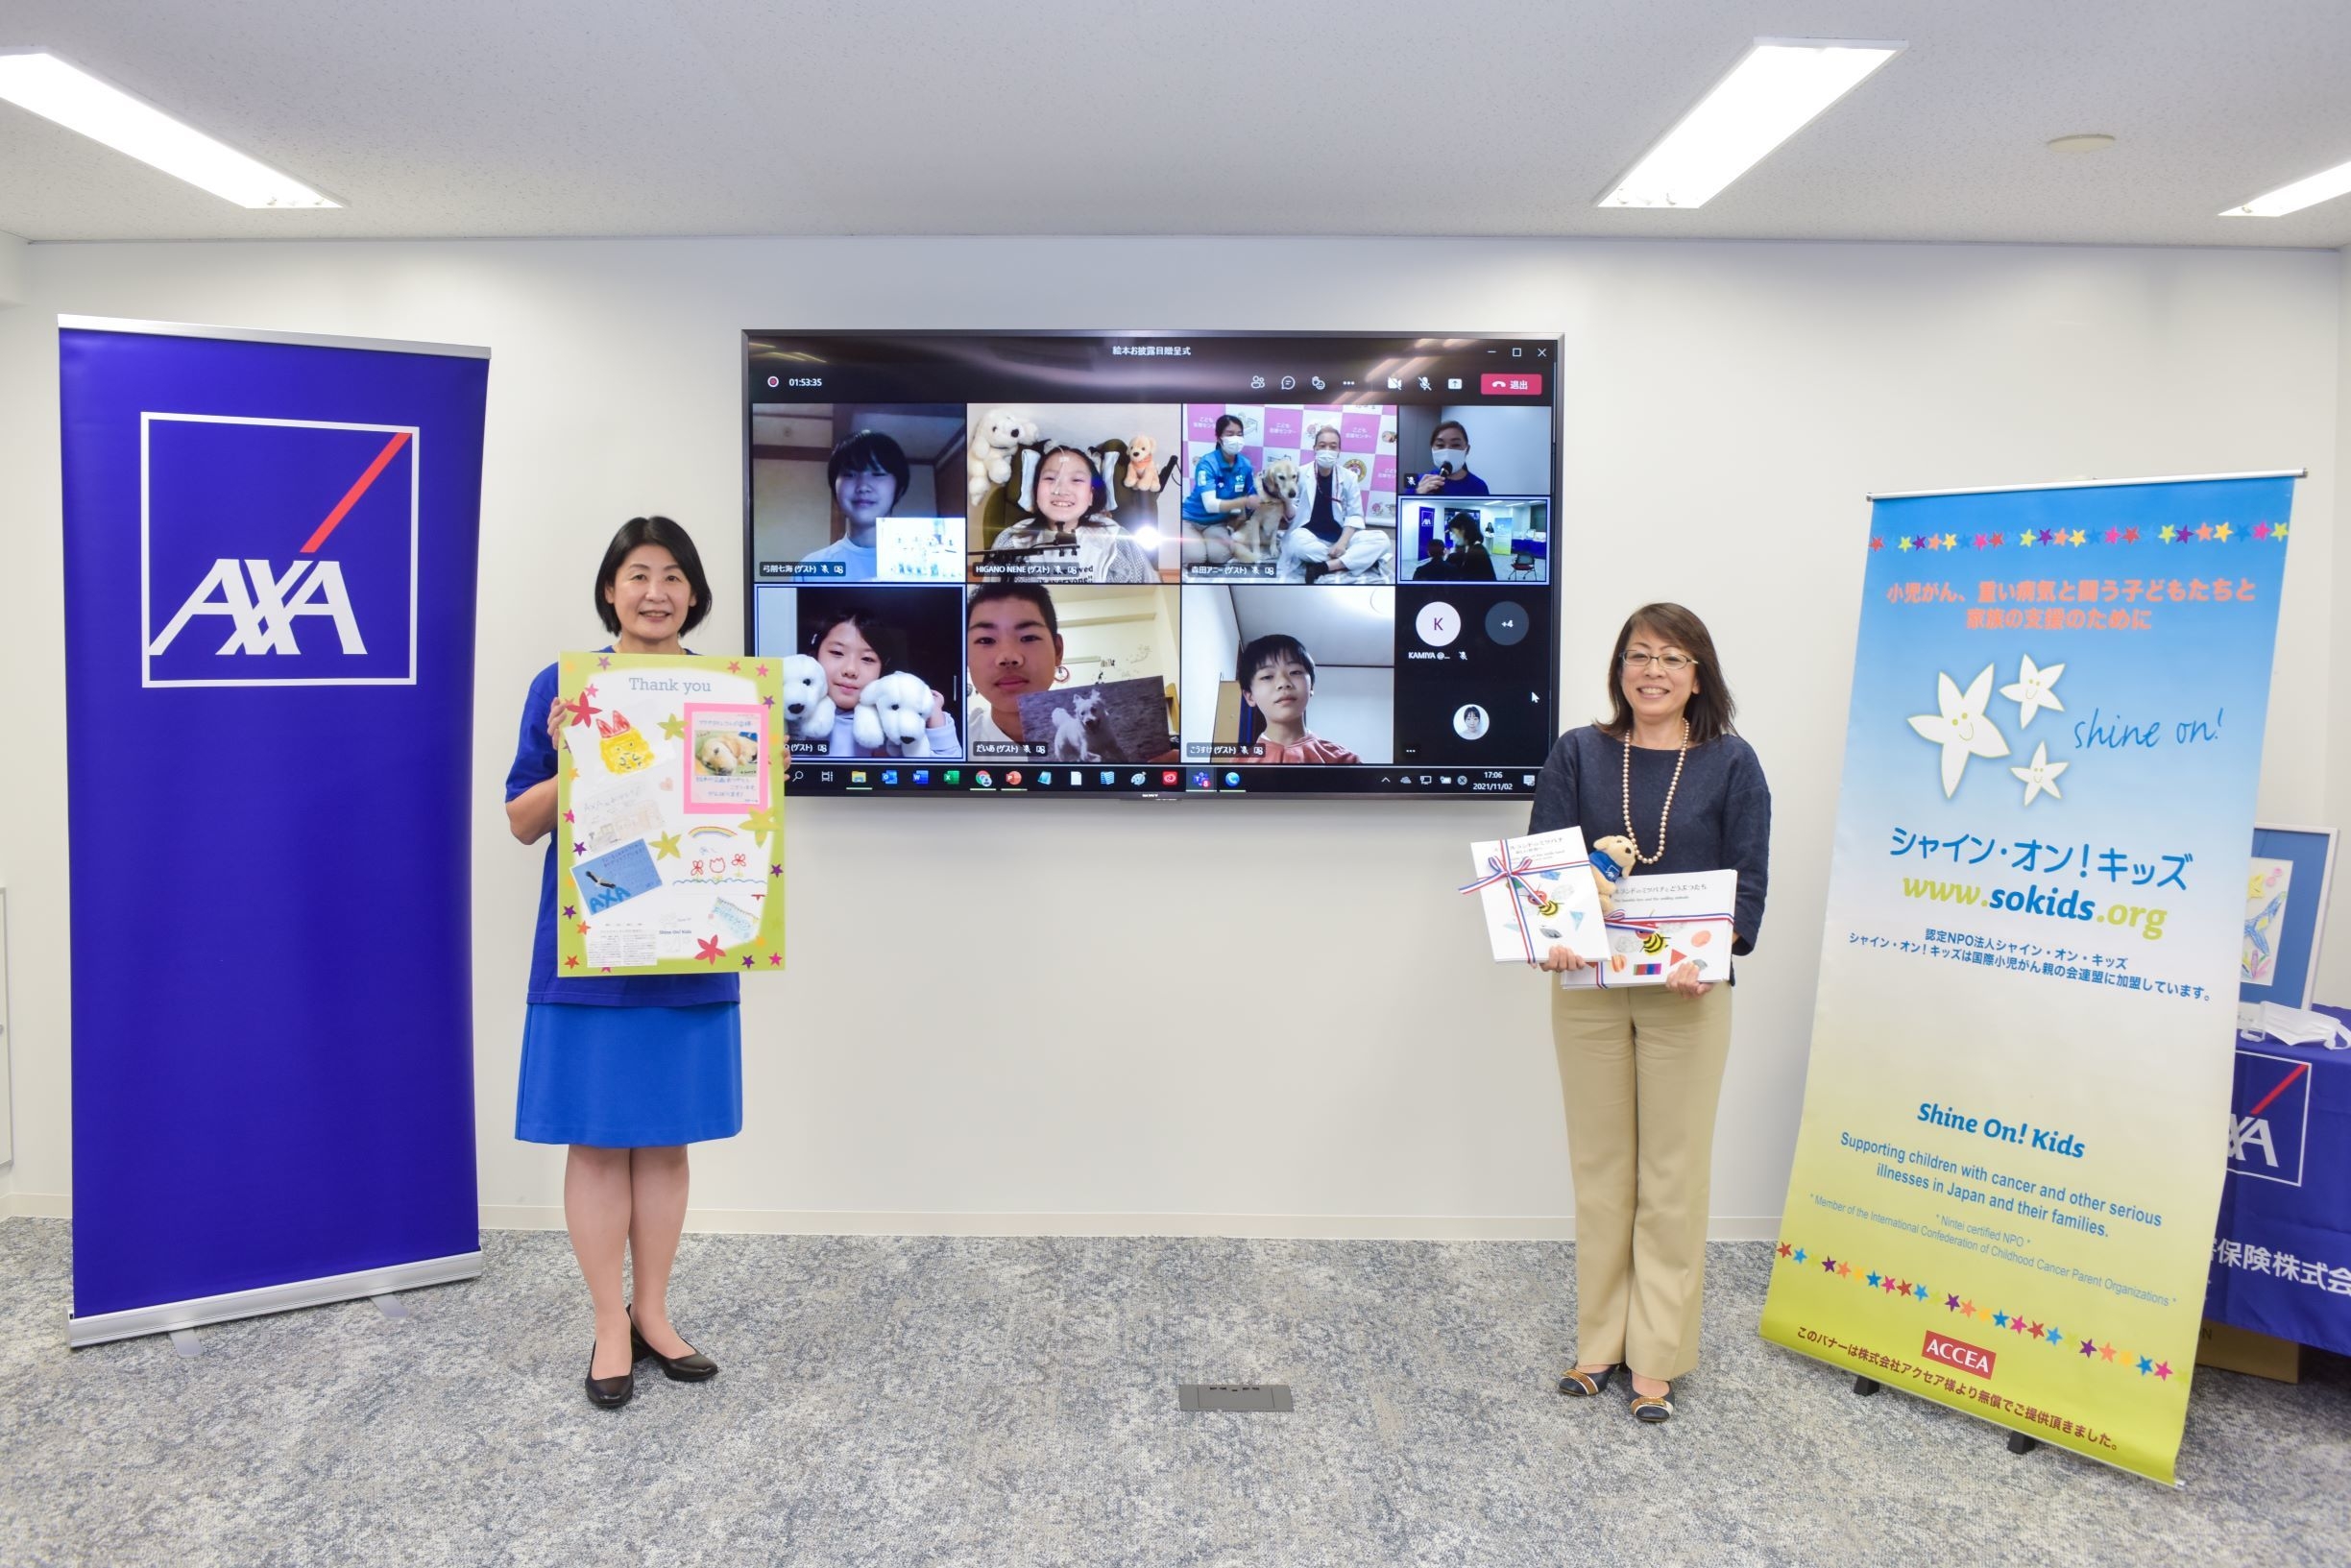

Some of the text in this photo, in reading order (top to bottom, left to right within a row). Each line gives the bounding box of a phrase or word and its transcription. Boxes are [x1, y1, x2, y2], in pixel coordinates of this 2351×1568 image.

[788, 377, 822, 387] 01:53:35
[1510, 379, 1529, 390] 退出
[794, 565, 816, 574] (ゲスト)
[1028, 566, 1050, 574] (ゲスト)
[1224, 567, 1248, 575] (ゲスト)
[146, 558, 369, 656] AXA
[1966, 608, 2151, 630] 家族の支援のために
[1434, 617, 1444, 631] K
[1501, 619, 1514, 628] +4
[629, 677, 712, 695] Thank you
[2074, 708, 2224, 749] shine on!
[790, 744, 813, 753] (ゲスト)
[1189, 746, 1237, 755] こうすけ (ゲスト)
[589, 886, 631, 913] AXA
[1903, 876, 2168, 940] www.sokids.org
[1925, 928, 2128, 971] 認定NPO法人シャイン・オン・キッズ
[1917, 1102, 2086, 1158] Shine On! Kids
[1840, 1132, 2163, 1227] Supporting children with cancer and other serious
[1876, 1163, 2110, 1238] illnesses in Japan and their families.
[1941, 1215, 2024, 1248] Nintei certified NPO
[1814, 1196, 2169, 1307] Member of the International Confederation of Childhood Cancer Parent Organizations
[1926, 1338, 1990, 1373] ACCEA
[1797, 1325, 2118, 1451] このバナーは株式会社アクセア様より無償でご提供頂きました。
